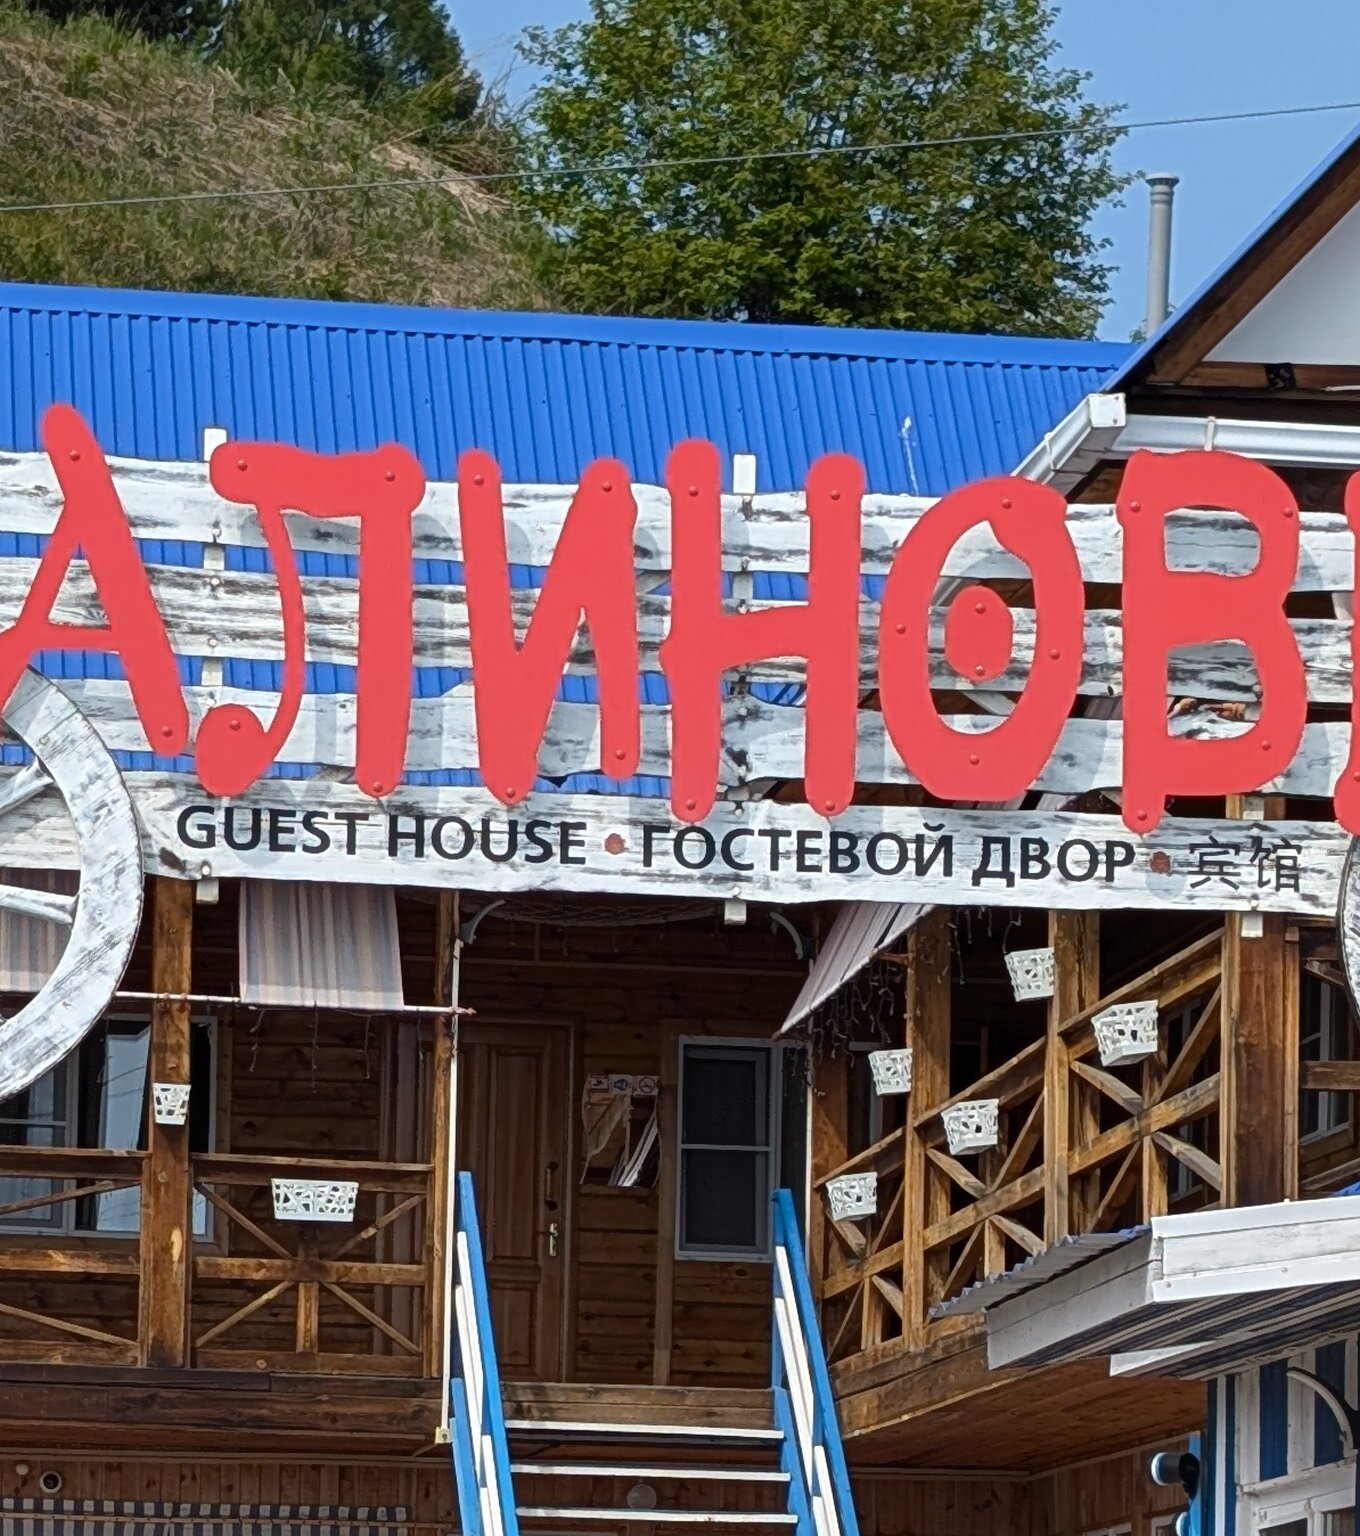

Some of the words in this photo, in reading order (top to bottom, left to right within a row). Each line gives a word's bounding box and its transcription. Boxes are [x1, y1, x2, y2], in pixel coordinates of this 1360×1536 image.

[176, 805, 370, 855] GUEST
[387, 813, 587, 864] HOUSE
[642, 822, 953, 877] ГОСТЕВОЙ
[971, 836, 1136, 888] ДВОР
[1188, 834, 1303, 893] 宾馆
